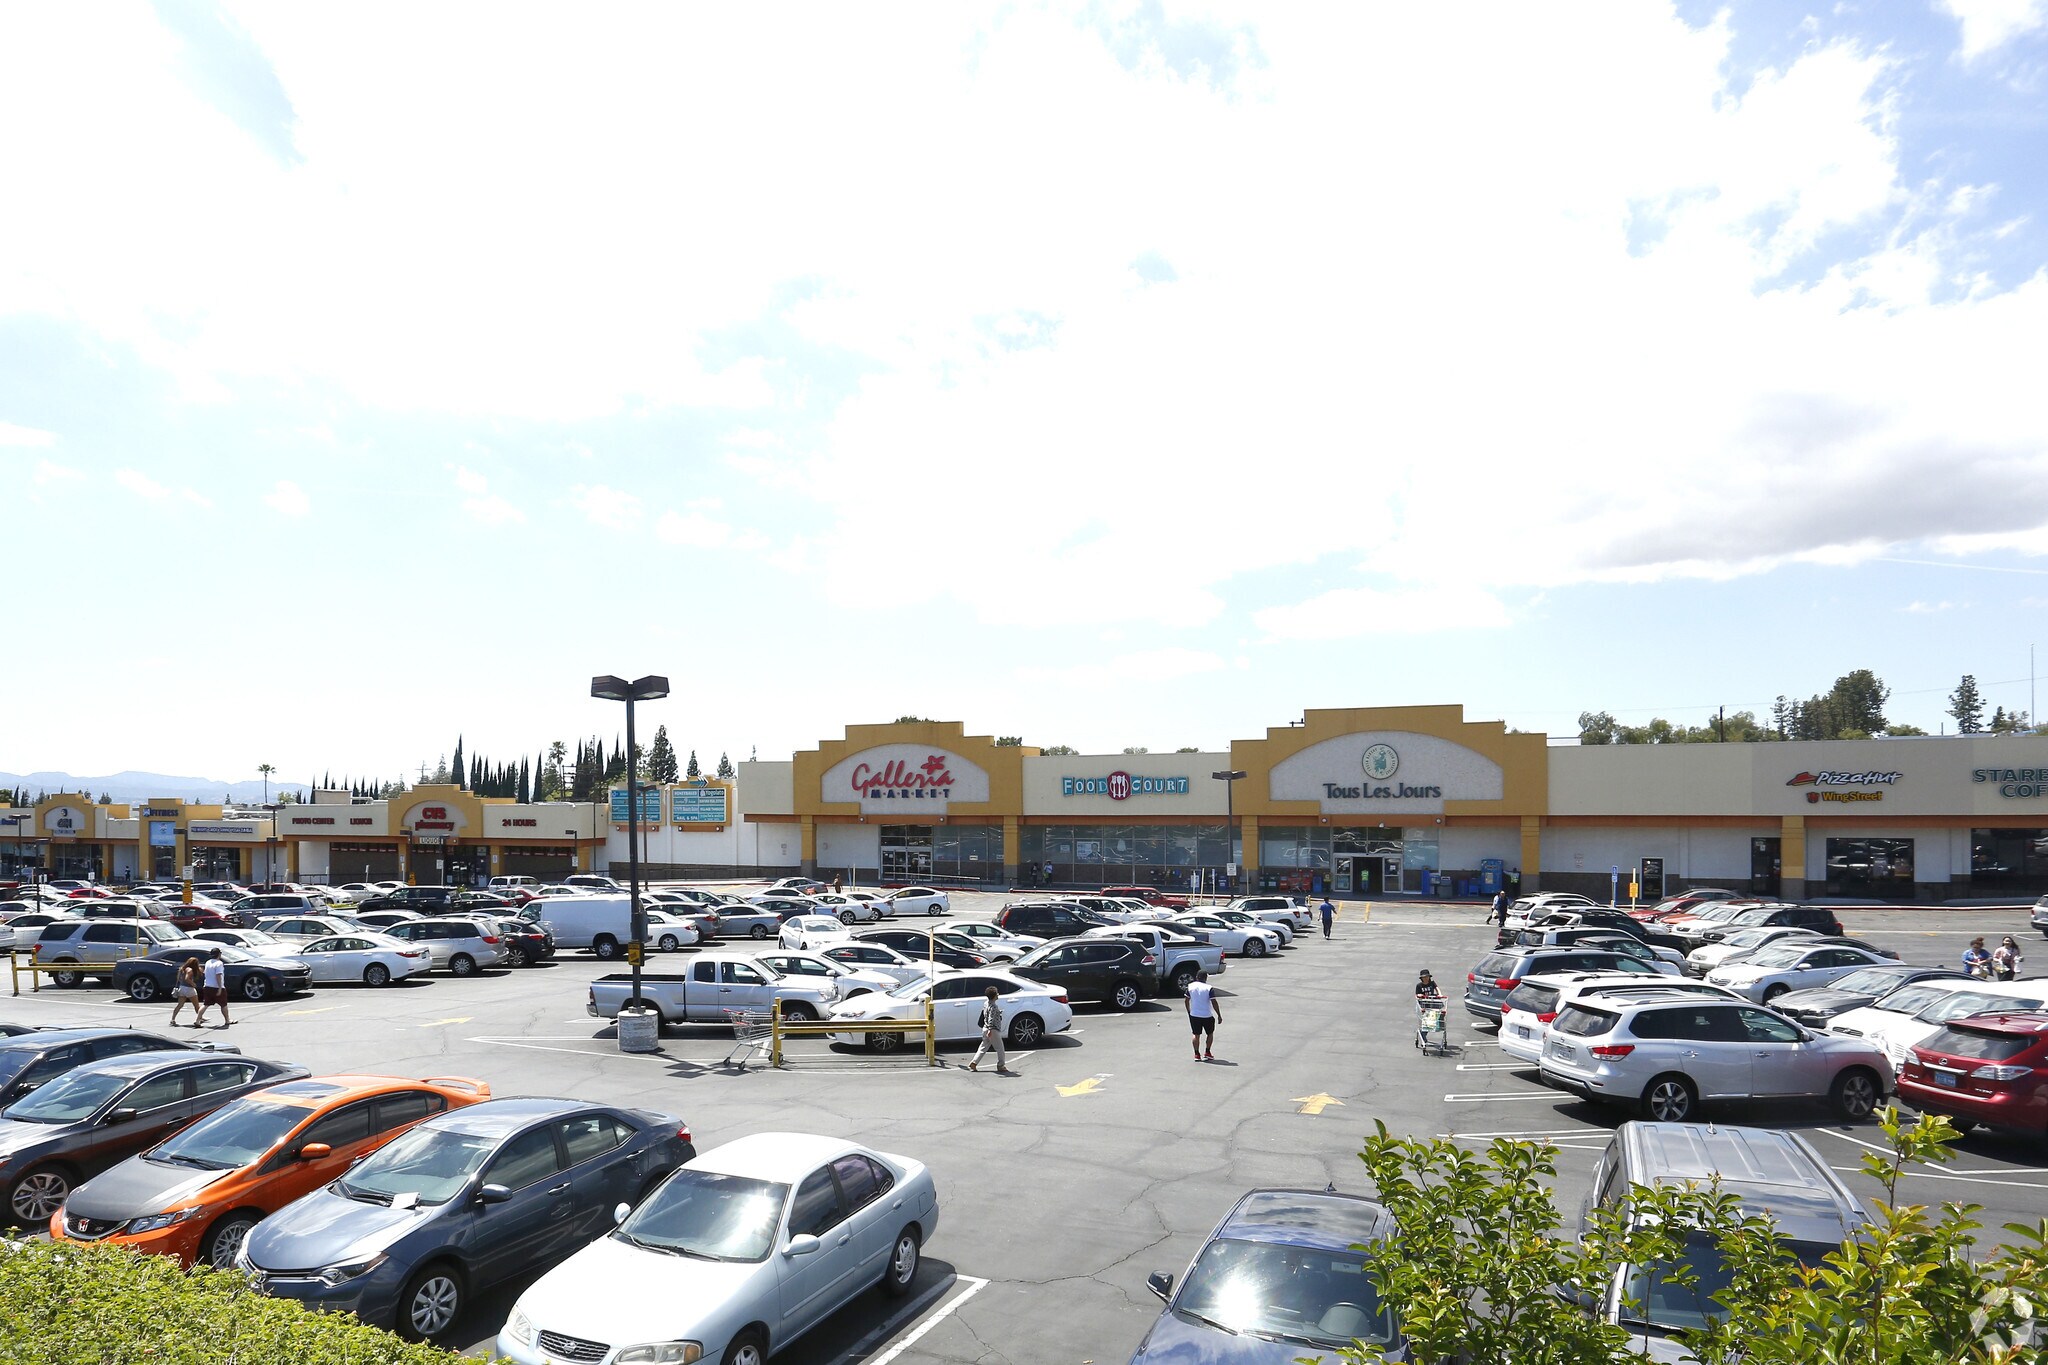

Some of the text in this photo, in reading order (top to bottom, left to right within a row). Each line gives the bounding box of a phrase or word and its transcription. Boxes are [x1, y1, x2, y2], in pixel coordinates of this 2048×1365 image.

[851, 758, 956, 798] Galleria
[1814, 770, 1863, 786] Pizza
[1972, 768, 2048, 783] STARB
[1063, 778, 1188, 795] FOOD COURT
[1322, 782, 1442, 799] Tous Les Jours
[2000, 784, 2048, 799] COF
[150, 809, 179, 817] FITNESS
[421, 807, 447, 820] CVS
[291, 817, 335, 825] PHOTO CENTER
[349, 817, 373, 825] LIQUOR
[414, 820, 455, 832] pharmacy
[501, 818, 537, 827] 24 HOURS
